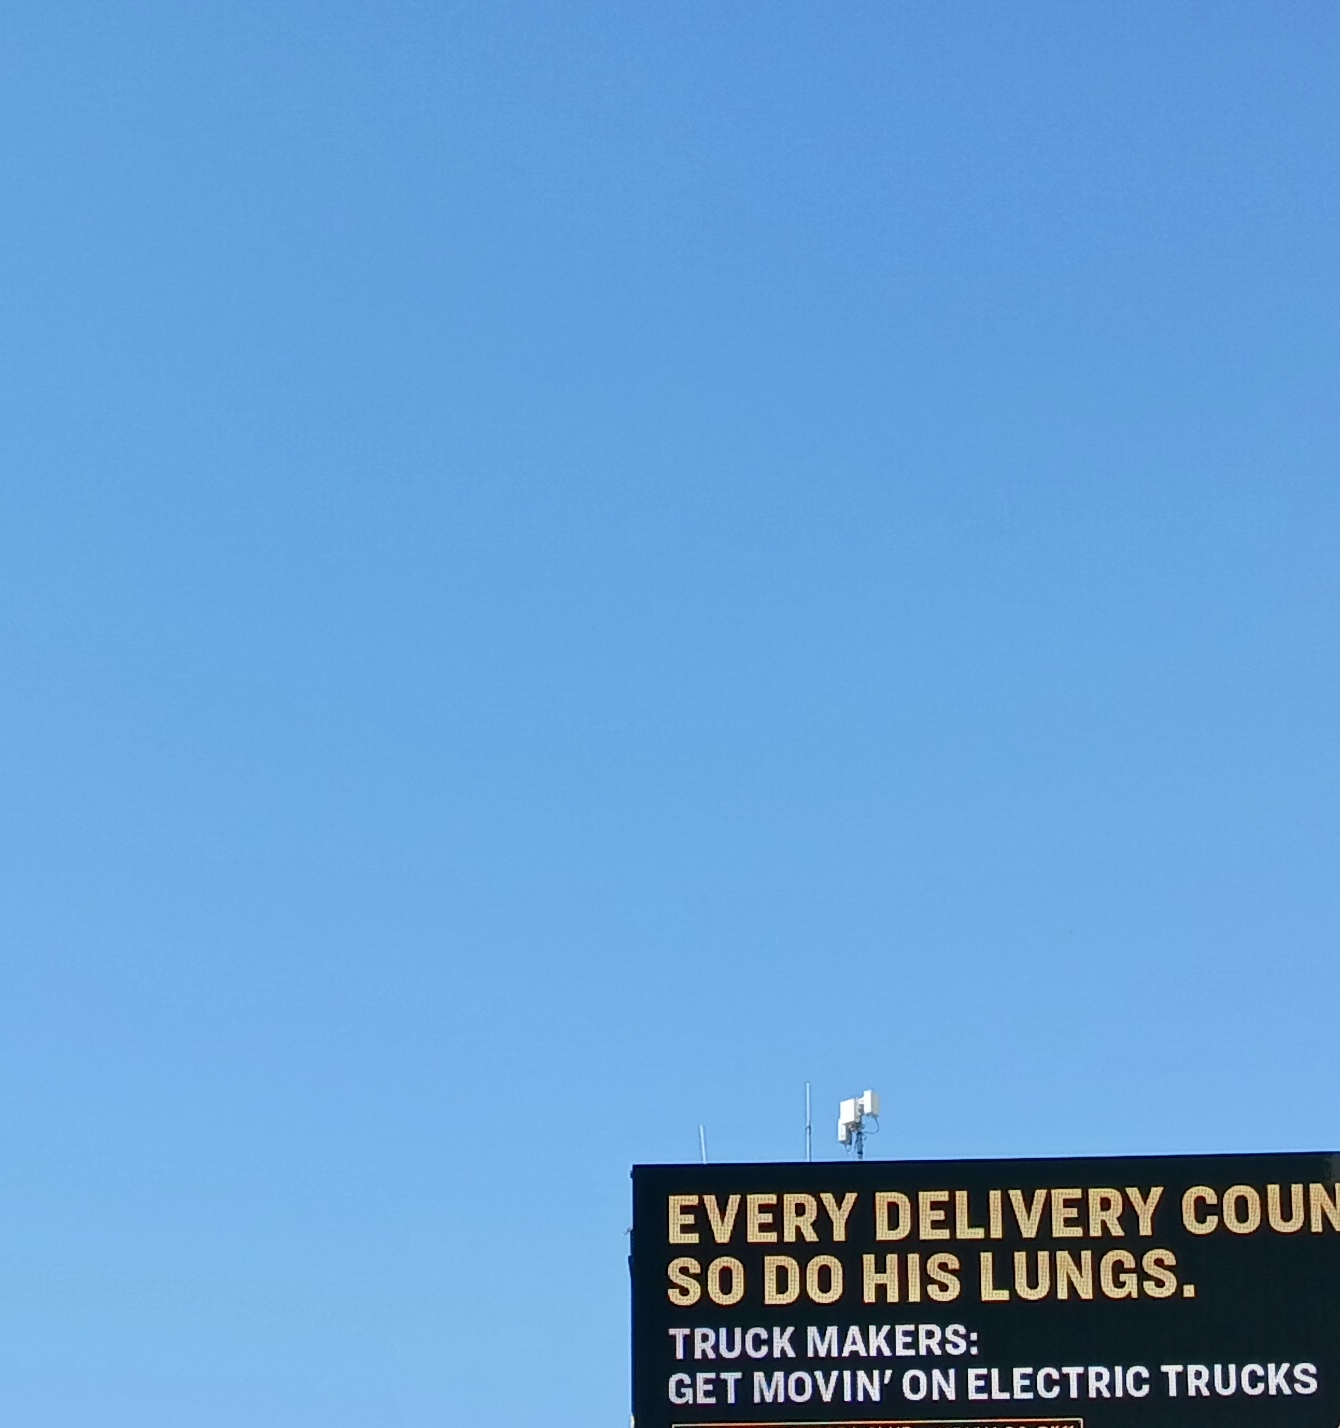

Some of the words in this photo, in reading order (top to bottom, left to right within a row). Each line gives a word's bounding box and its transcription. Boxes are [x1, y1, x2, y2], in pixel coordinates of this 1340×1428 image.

[669, 1192, 858, 1244] EVERY
[876, 1187, 1164, 1241] DELIVERY
[668, 1256, 745, 1306] SO
[765, 1255, 844, 1305] DO
[863, 1252, 961, 1304] HIS
[980, 1248, 1196, 1302] LUNGS.
[669, 1326, 796, 1360] TRUCK
[807, 1323, 979, 1358] MAKERS:
[669, 1371, 743, 1405] GET
[754, 1369, 892, 1404] MOVIN'
[903, 1367, 956, 1401] ON
[968, 1365, 1150, 1401] ELECTRIC
[1161, 1362, 1318, 1397] TRUCKS
